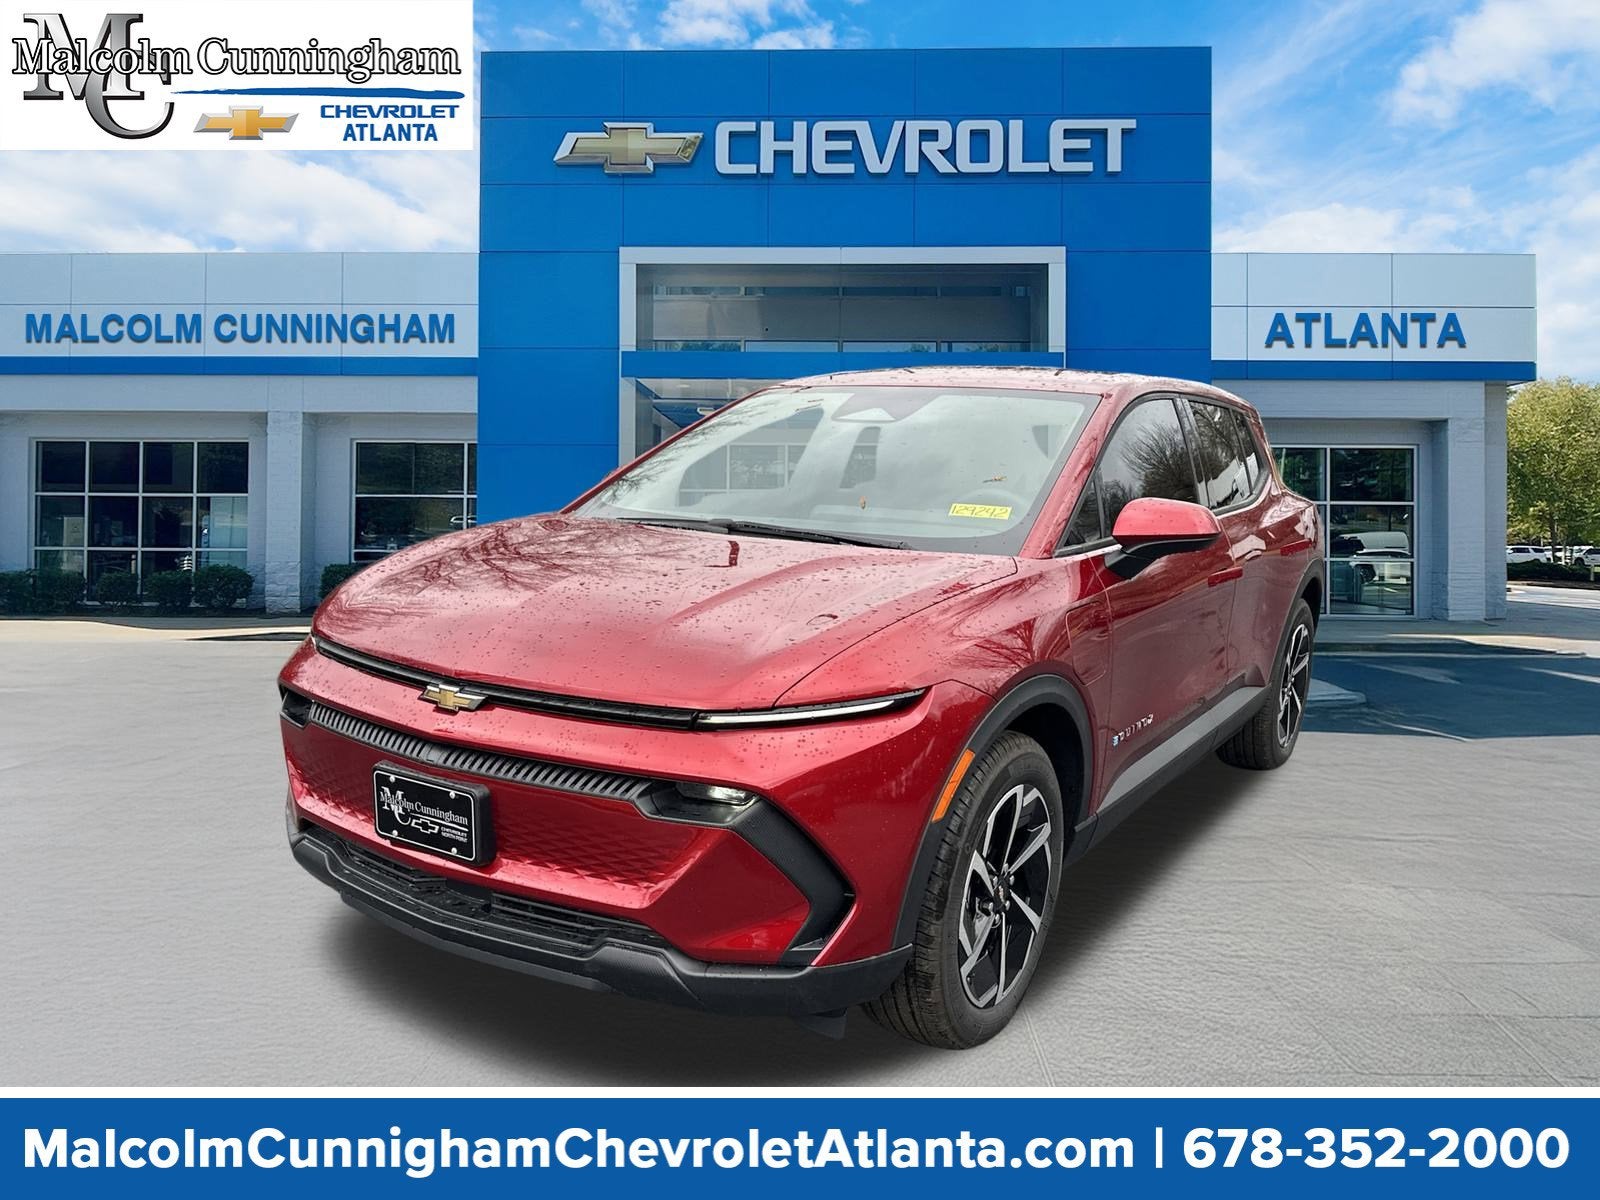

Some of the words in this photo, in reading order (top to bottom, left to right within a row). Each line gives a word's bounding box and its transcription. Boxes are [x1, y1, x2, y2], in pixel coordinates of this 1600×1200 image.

[714, 119, 1137, 175] CHEVROLET
[25, 313, 202, 344] MALCOLM
[213, 313, 456, 344] CUNNINGHAM
[1265, 312, 1467, 348] ATLANTA
[951, 505, 1009, 518] 129242
[380, 791, 414, 811] Malcolm
[414, 801, 468, 825] Cunningham
